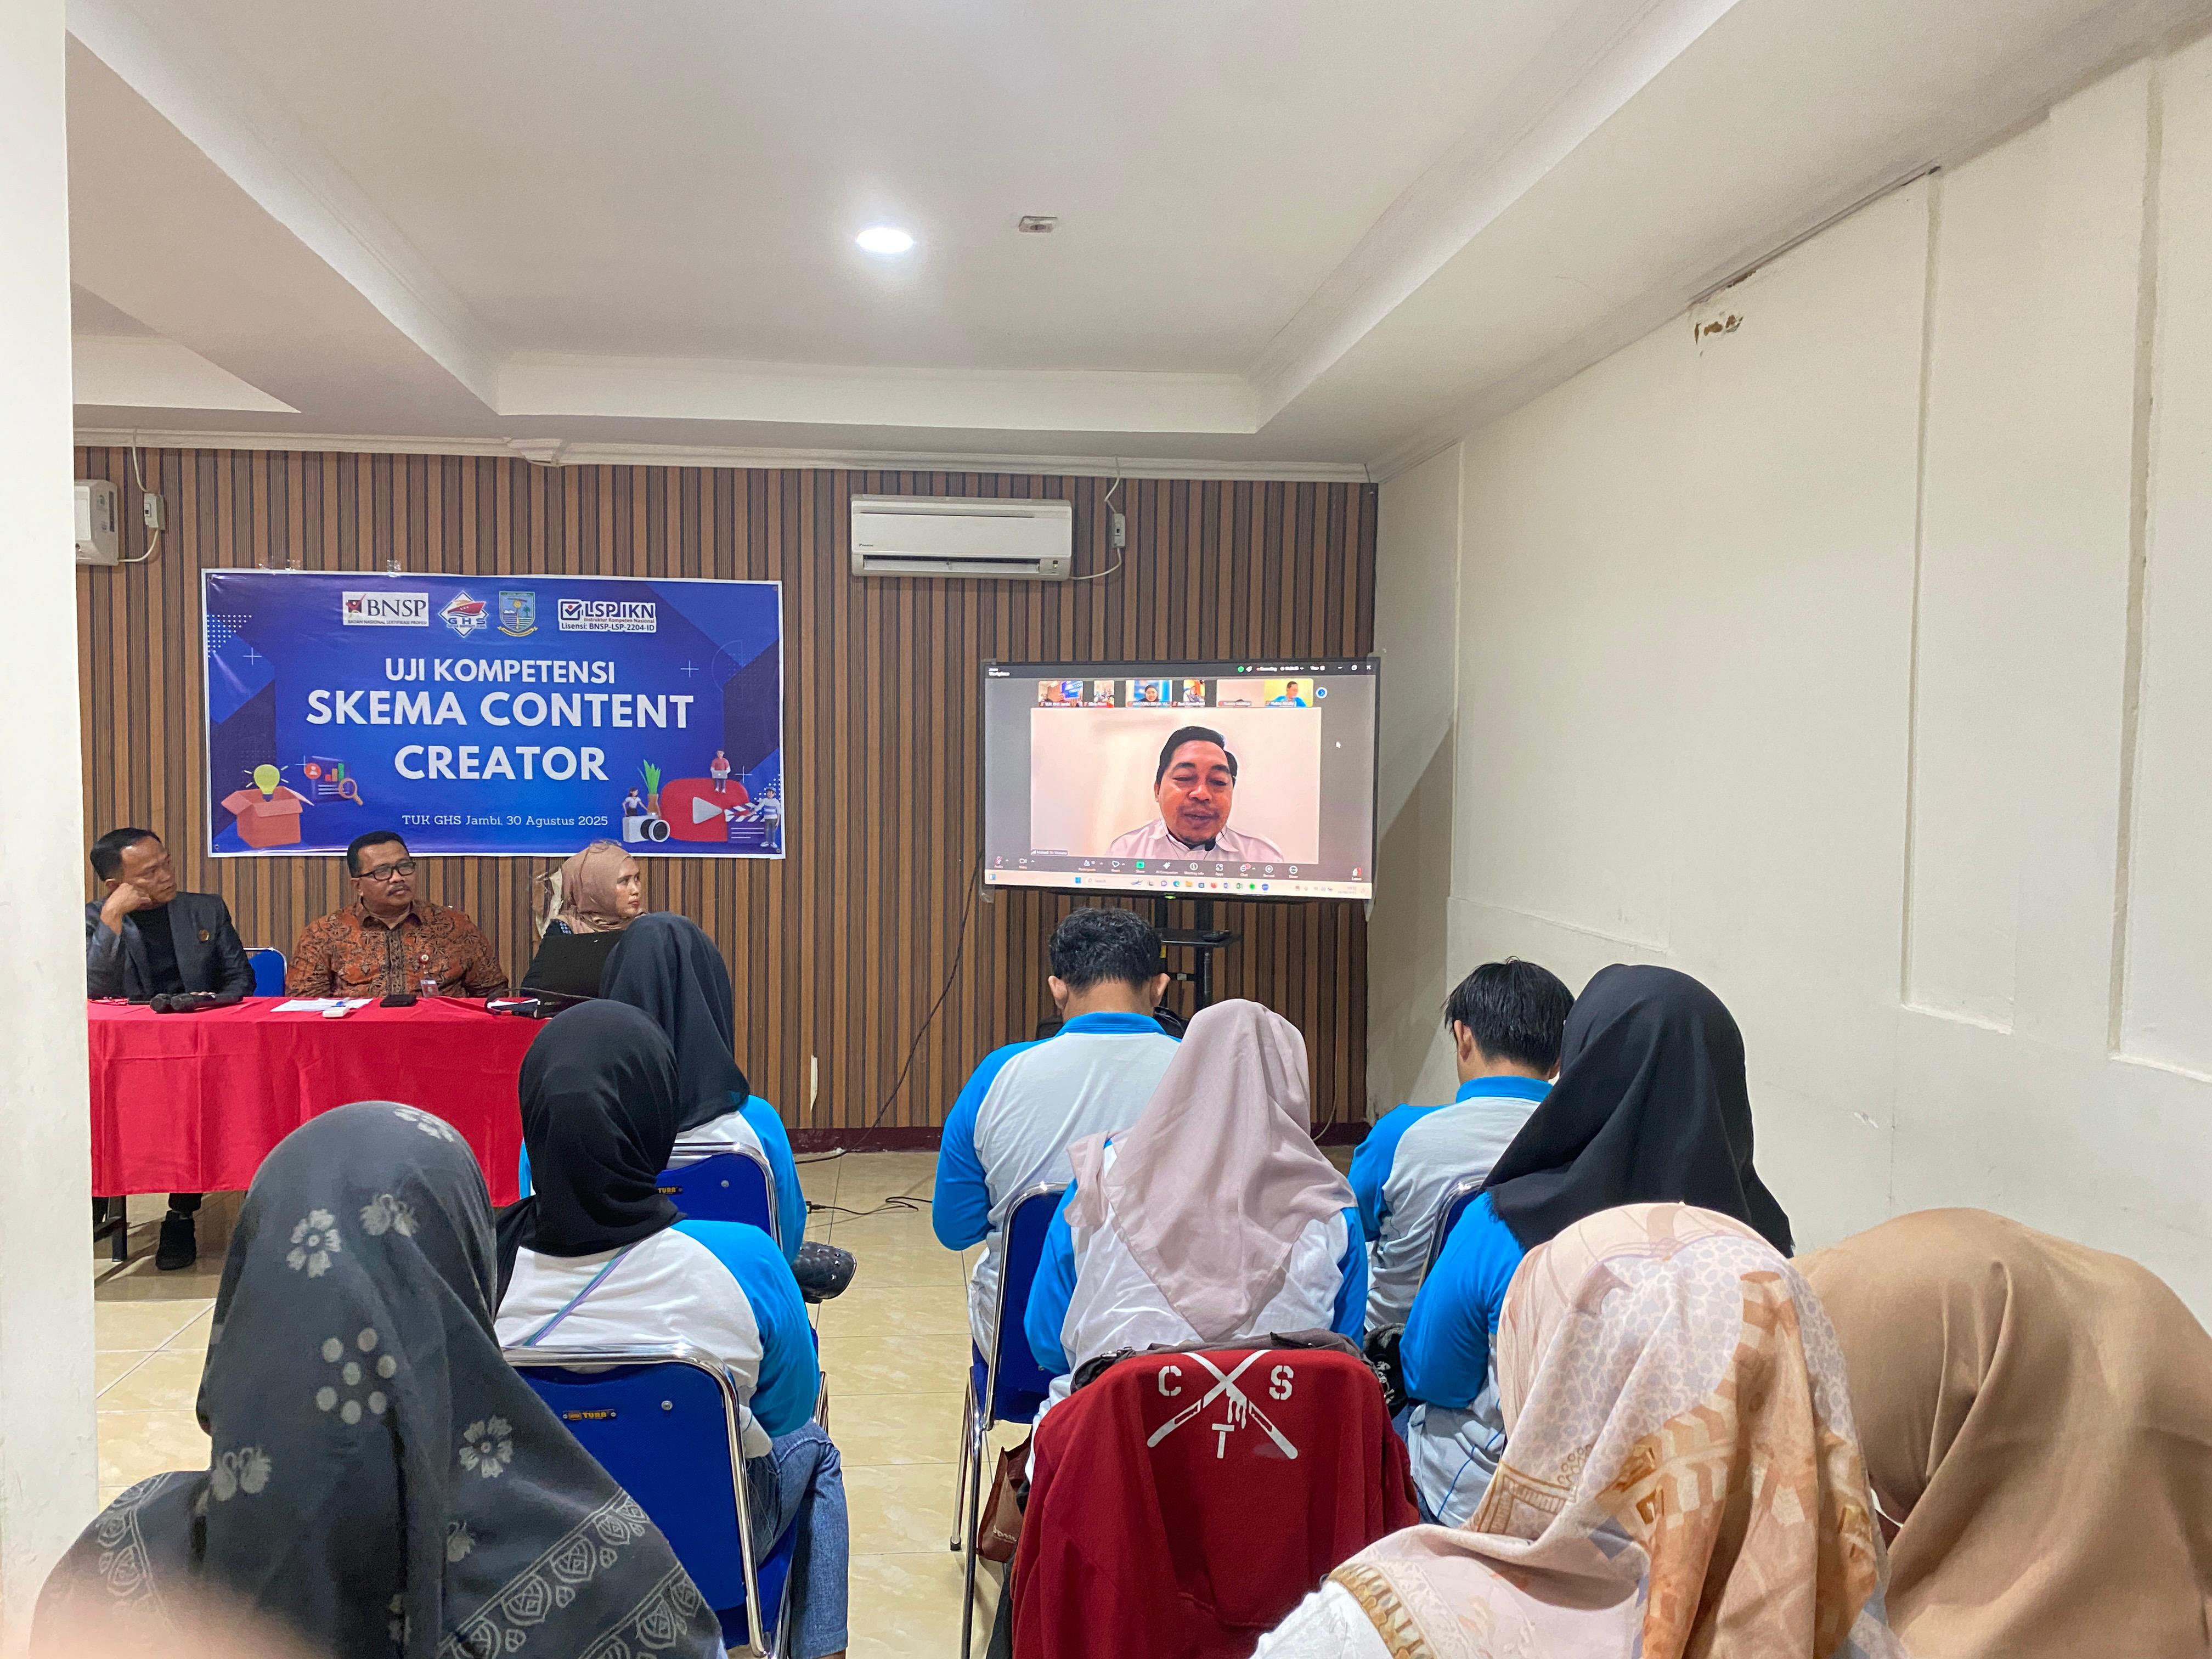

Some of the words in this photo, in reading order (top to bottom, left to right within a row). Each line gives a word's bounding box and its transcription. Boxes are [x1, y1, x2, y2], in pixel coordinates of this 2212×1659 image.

[367, 599, 427, 617] BNSP
[386, 658, 425, 681] UJI
[434, 659, 615, 684] KOMPETENSI
[306, 689, 467, 725] SKEMA
[480, 691, 694, 727] CONTENT
[394, 744, 609, 780] CREATOR
[402, 815, 431, 825] TUK
[434, 815, 461, 825] GHS
[506, 816, 522, 826] 30
[526, 816, 575, 827] Agustus
[578, 816, 608, 826] 2025
[1158, 1365, 1182, 1397] C
[1269, 1364, 1294, 1401] S
[1211, 1423, 1235, 1459] T
